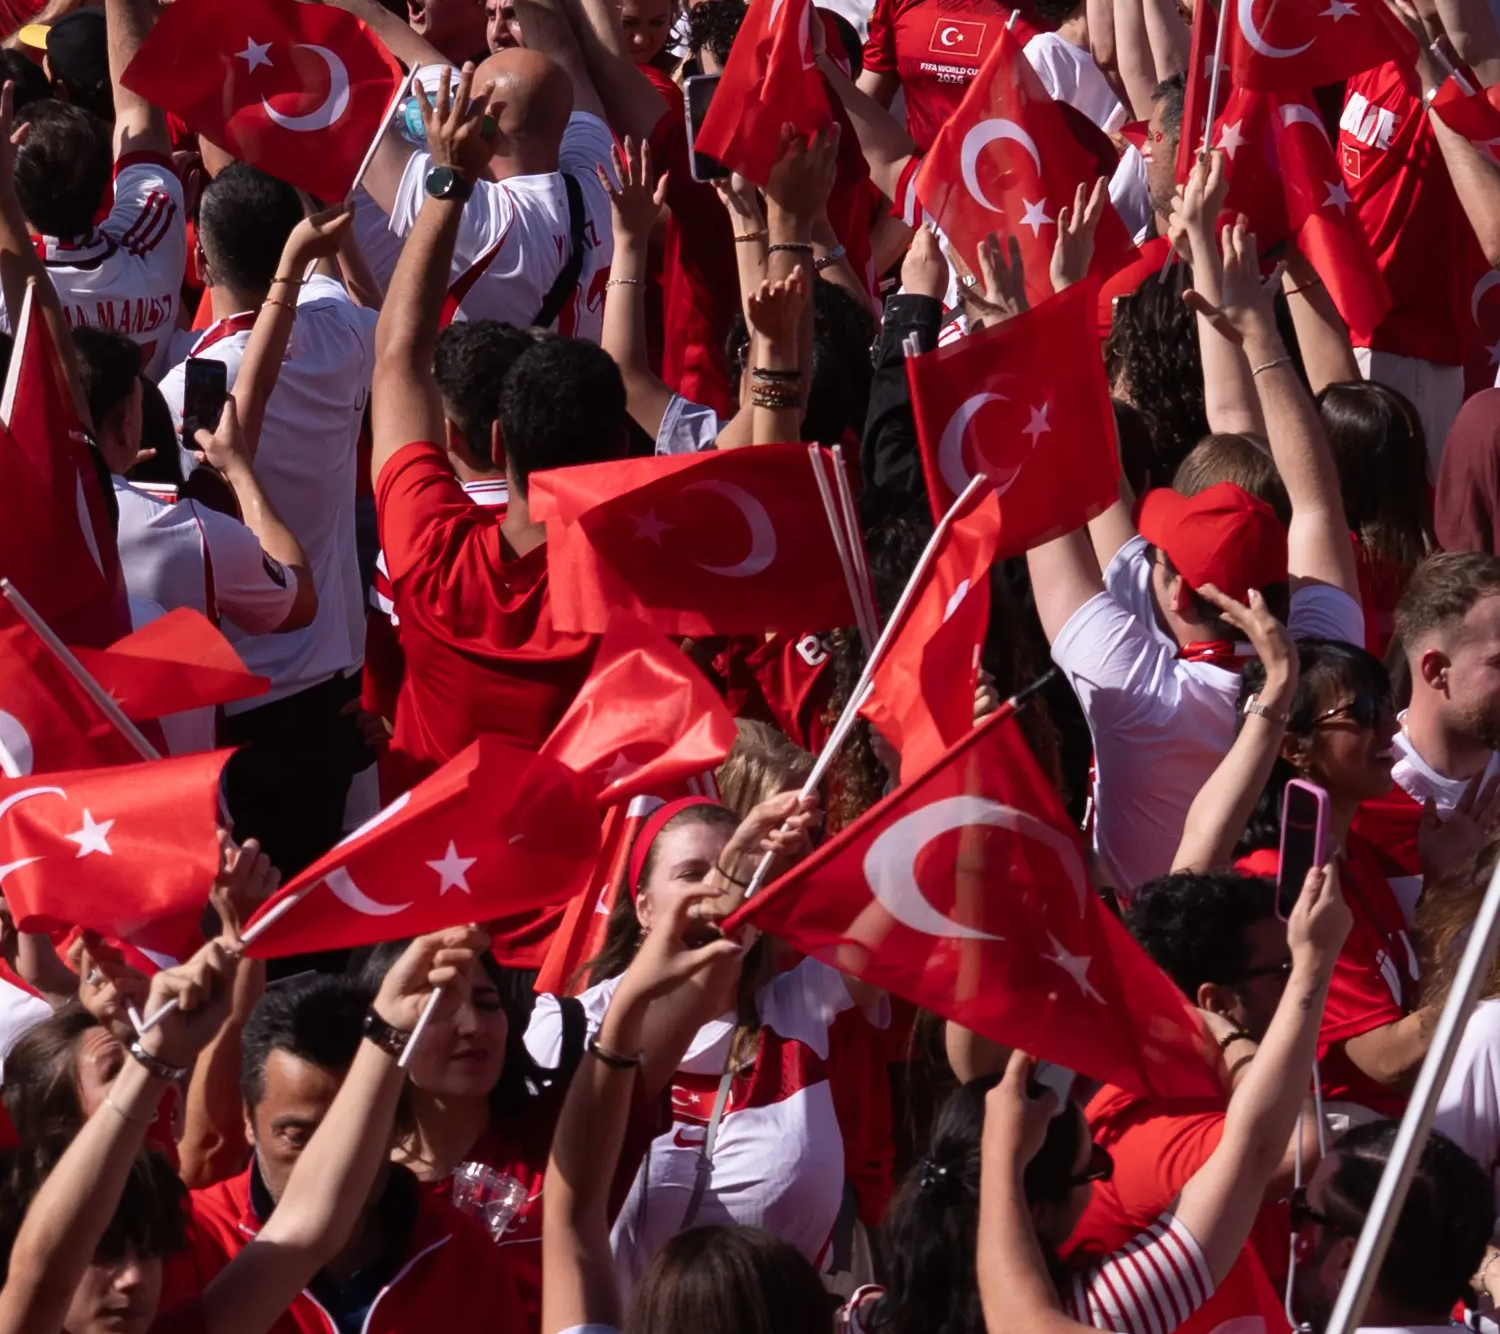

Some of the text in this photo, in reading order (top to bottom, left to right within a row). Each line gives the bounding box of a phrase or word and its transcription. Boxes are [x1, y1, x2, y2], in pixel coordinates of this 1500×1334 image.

[938, 64, 964, 75] WORLD
[964, 66, 980, 77] CU
[936, 73, 965, 85] 2026
